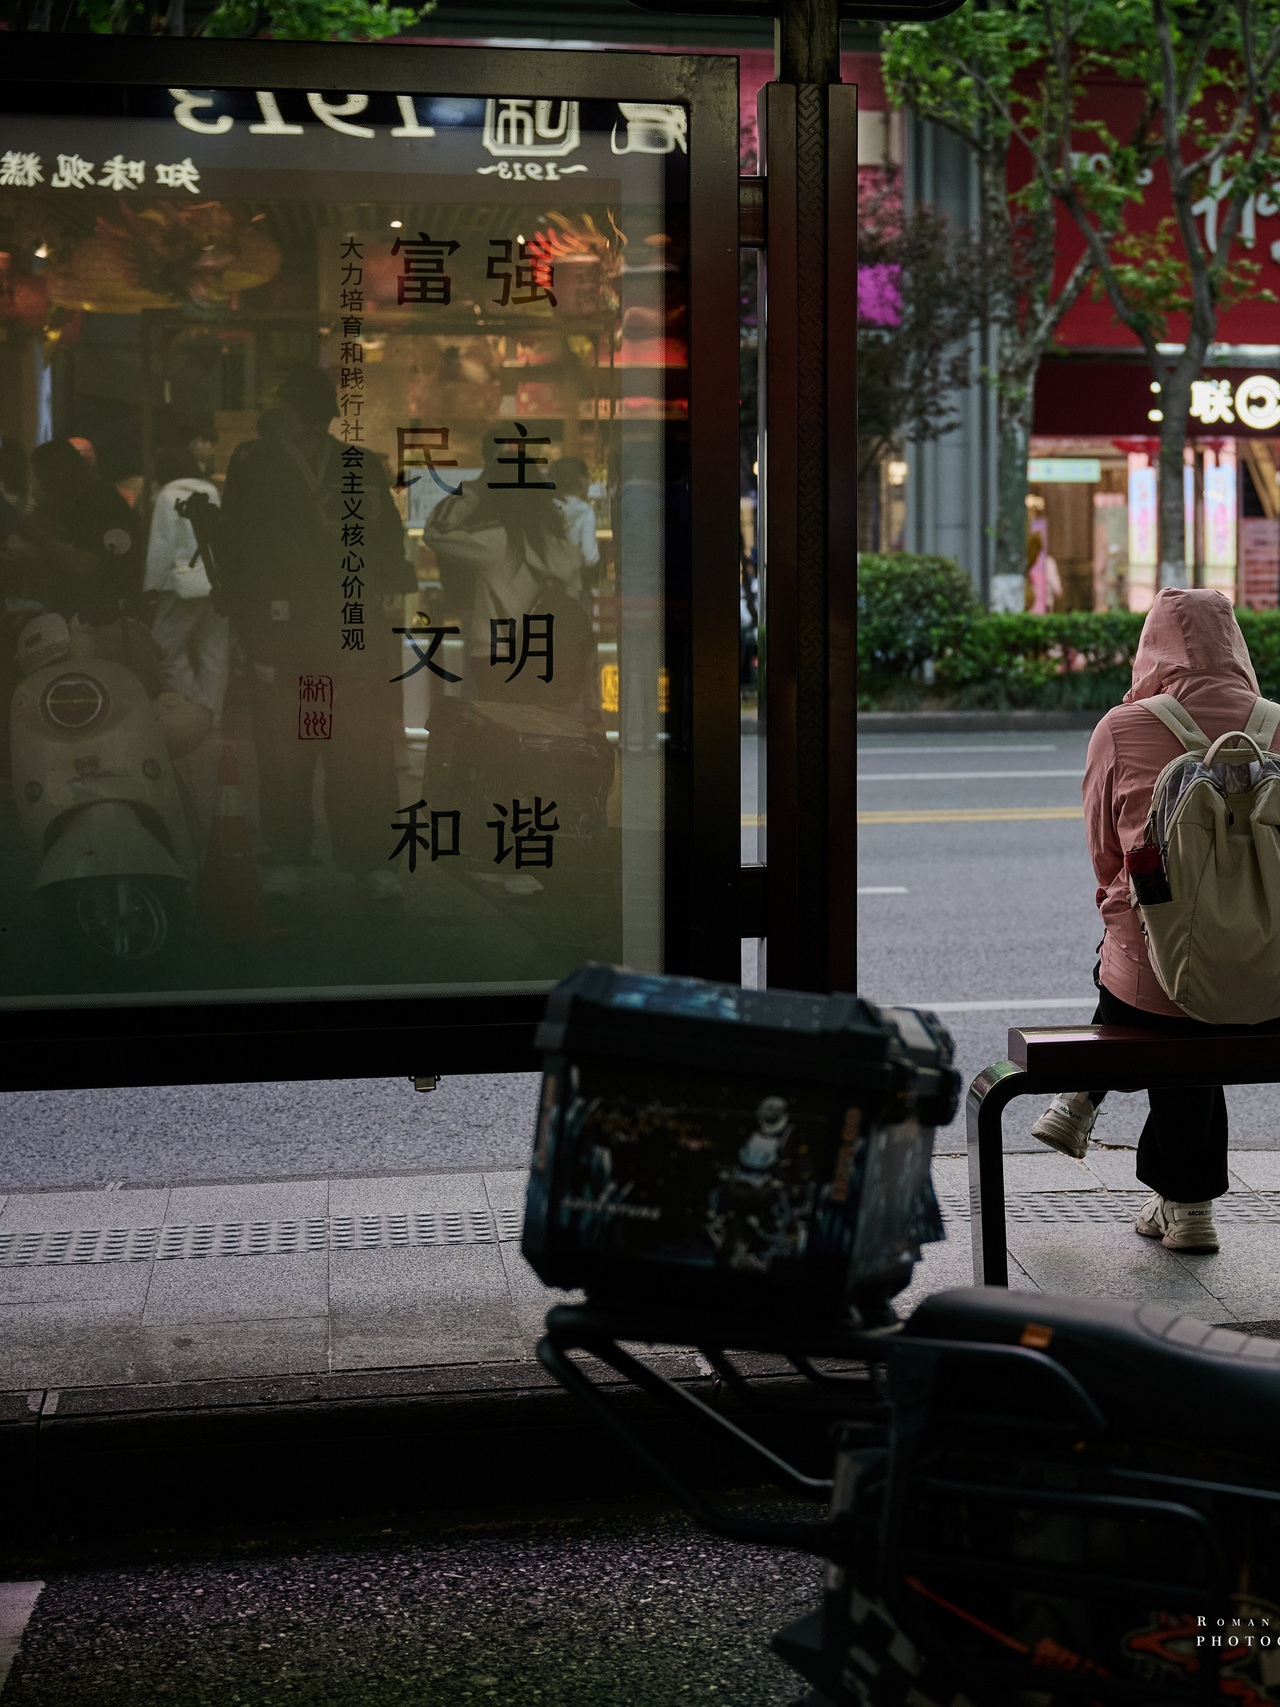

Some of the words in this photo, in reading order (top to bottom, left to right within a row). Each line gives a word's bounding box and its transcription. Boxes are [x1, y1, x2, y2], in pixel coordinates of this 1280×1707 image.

[390, 232, 558, 307] 富强
[340, 236, 365, 651] 大力培育和践行社会主义核心价值观
[392, 423, 557, 498] 民主
[389, 611, 555, 684] 文明
[388, 796, 560, 873] 和谐
